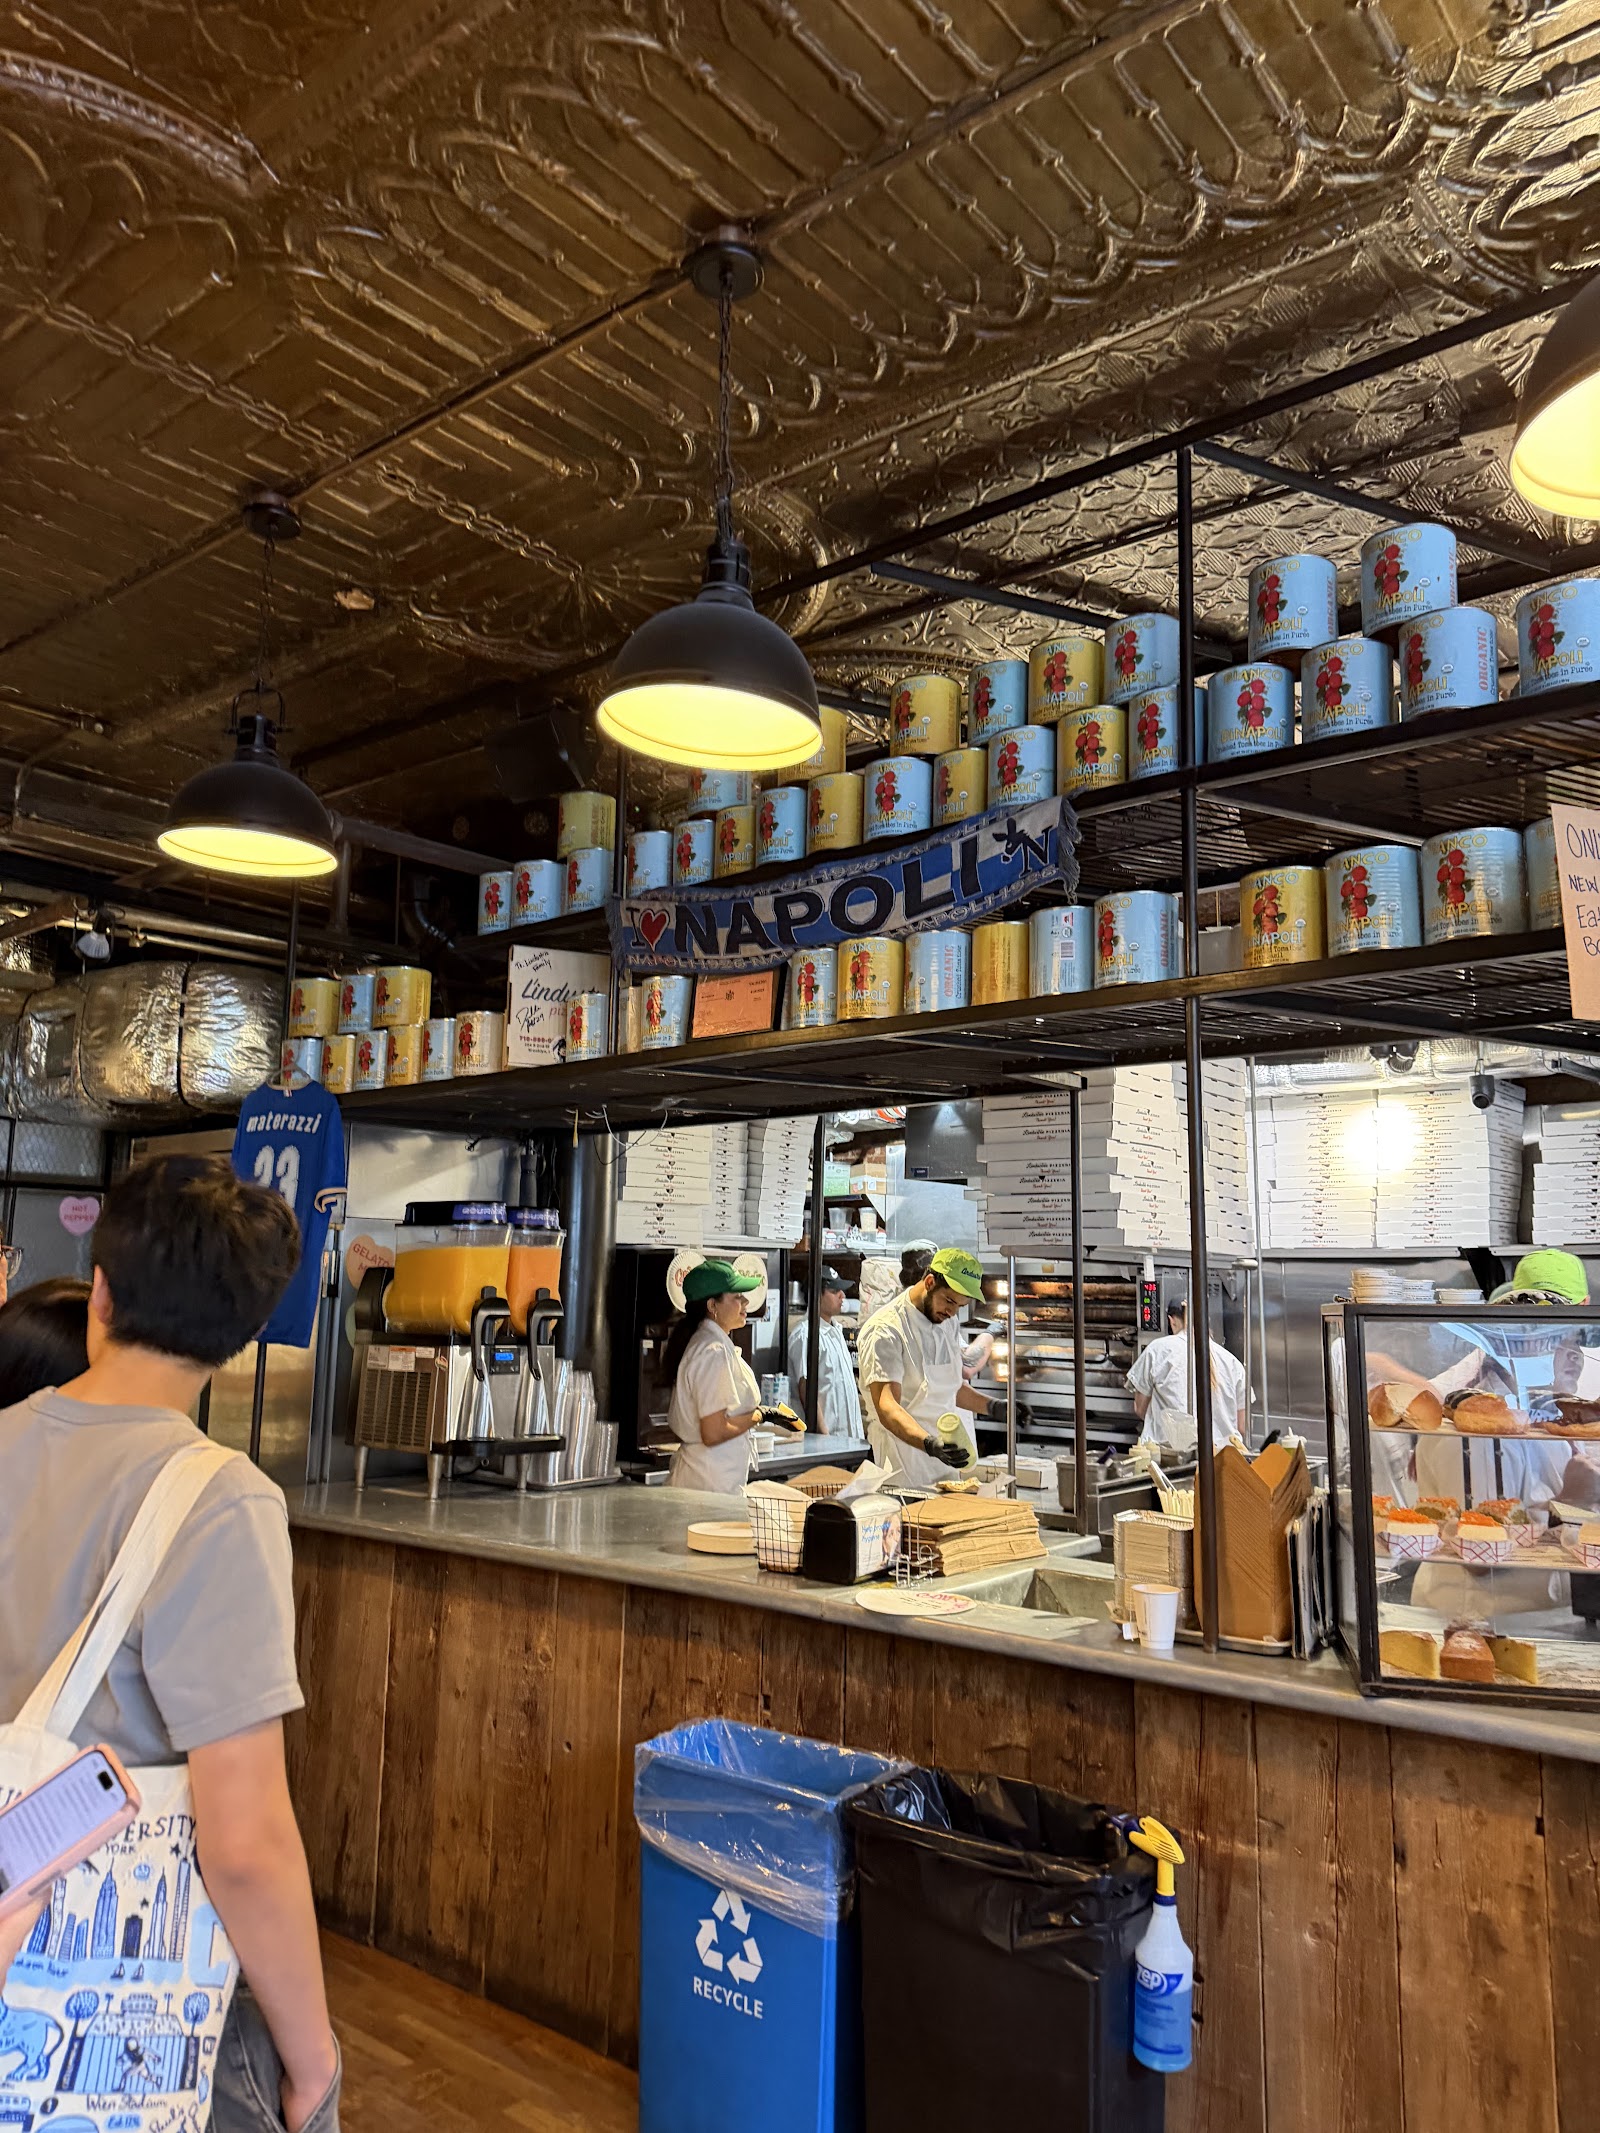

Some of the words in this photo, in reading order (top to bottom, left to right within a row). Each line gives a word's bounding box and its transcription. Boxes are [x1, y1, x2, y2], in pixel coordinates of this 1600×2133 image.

[1477, 626, 1489, 691] ORGANIC
[626, 907, 646, 948] I
[675, 835, 982, 955] NAPOLI
[1568, 874, 1599, 894] NEW
[943, 944, 955, 998] ORGANIC
[246, 1110, 322, 1134] materazzi
[353, 1243, 391, 1268] GELATO
[694, 1975, 764, 2020] RECYCLE
